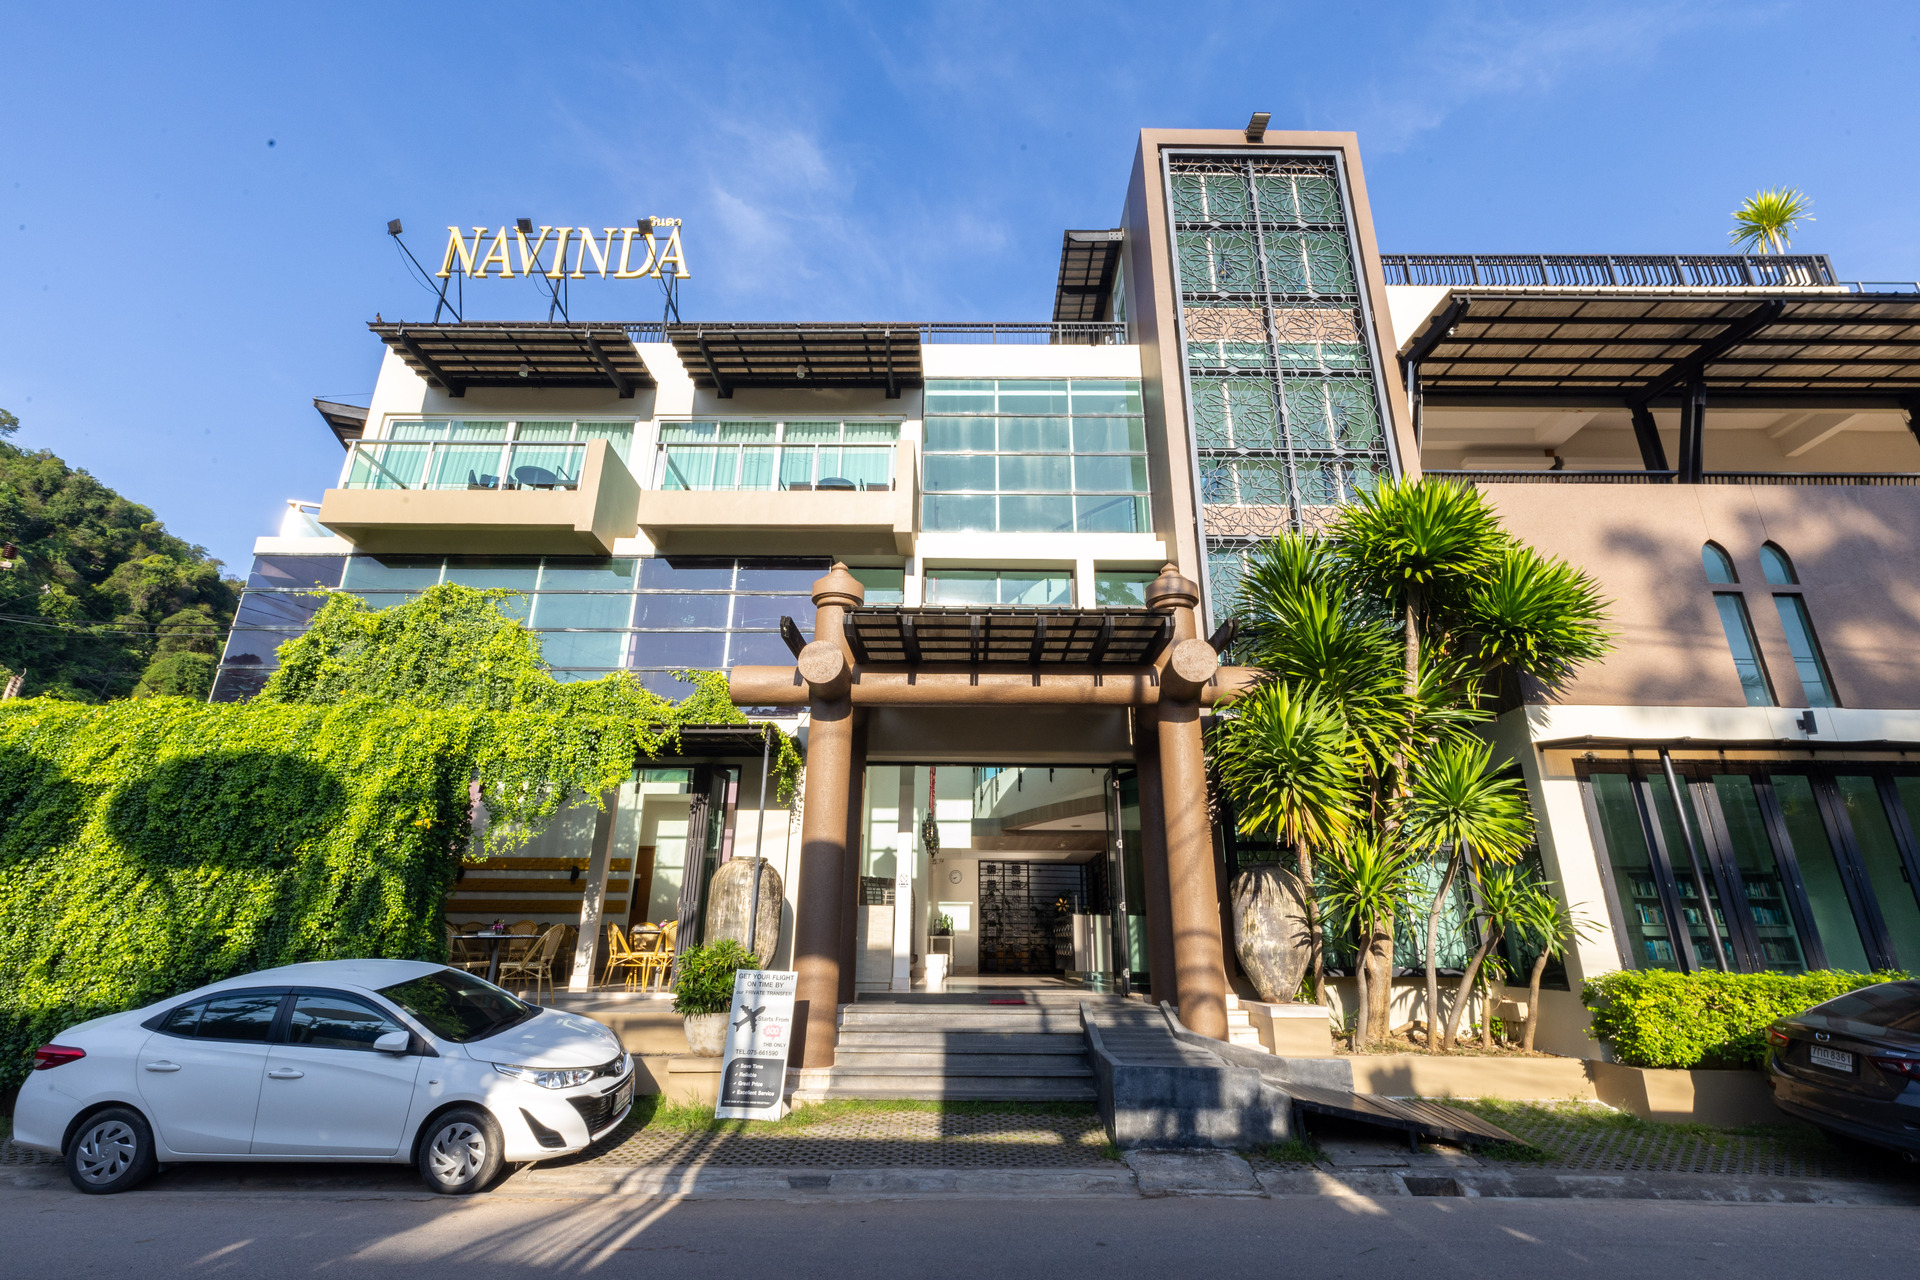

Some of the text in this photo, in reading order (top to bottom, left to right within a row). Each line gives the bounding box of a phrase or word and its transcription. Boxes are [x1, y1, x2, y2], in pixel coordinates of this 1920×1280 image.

[435, 226, 691, 279] NAVINDA
[765, 1027, 780, 1035] 600
[1830, 1050, 1851, 1064] 8361
